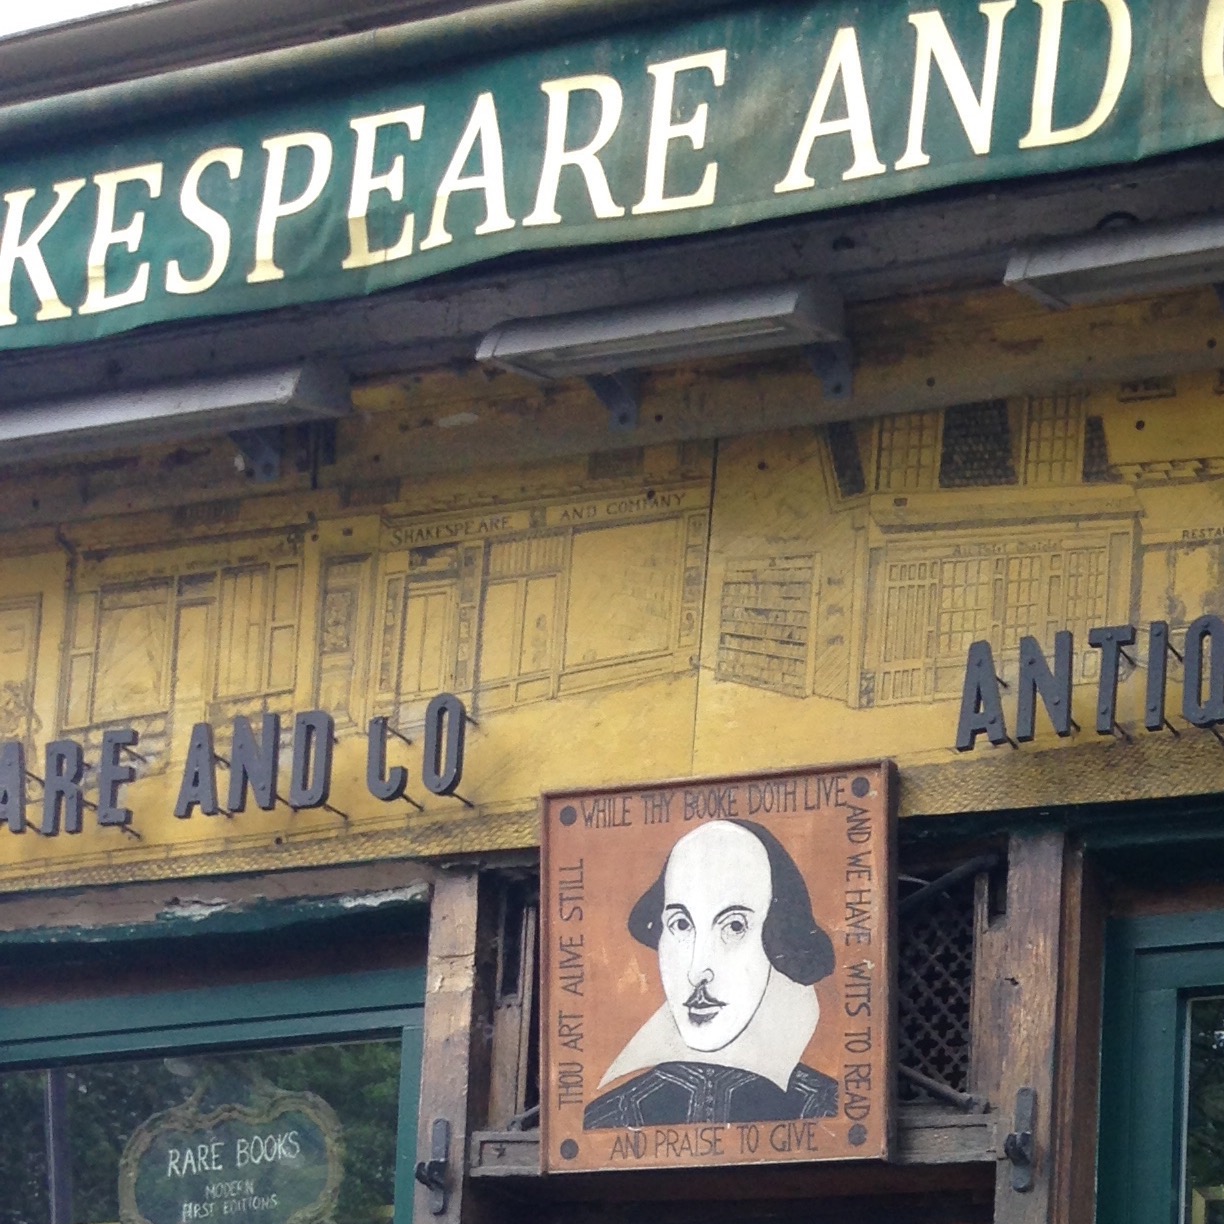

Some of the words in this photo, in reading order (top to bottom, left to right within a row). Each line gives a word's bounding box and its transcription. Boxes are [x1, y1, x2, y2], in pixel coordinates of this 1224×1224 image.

[773, 0, 1132, 195] AND
[390, 516, 511, 546] SHAKESPEARE
[560, 506, 596, 522] AND
[606, 492, 687, 515] COMPANY
[174, 710, 335, 819] AND
[581, 797, 632, 829] WHILE
[643, 794, 672, 824] THY
[684, 786, 739, 821] BOOKE
[748, 782, 797, 815] DOTH
[804, 774, 848, 811] LIVE
[845, 804, 872, 844] AND
[560, 858, 583, 921] STILL
[845, 853, 872, 882] WE
[844, 889, 872, 946] HAVE
[560, 934, 583, 996] ALIVE
[846, 958, 872, 1018] WITS
[559, 1010, 583, 1052] ART
[845, 1027, 872, 1053] TO
[558, 1061, 583, 1109] THOU
[844, 1064, 872, 1121] READ
[168, 1142, 224, 1177] RARE
[237, 1131, 300, 1167] BOOKS
[610, 1131, 648, 1160] AND
[655, 1126, 726, 1156] PRAISE
[737, 1127, 760, 1154] TO
[770, 1123, 819, 1152] GIVE
[223, 1194, 278, 1215] EDITIONS
